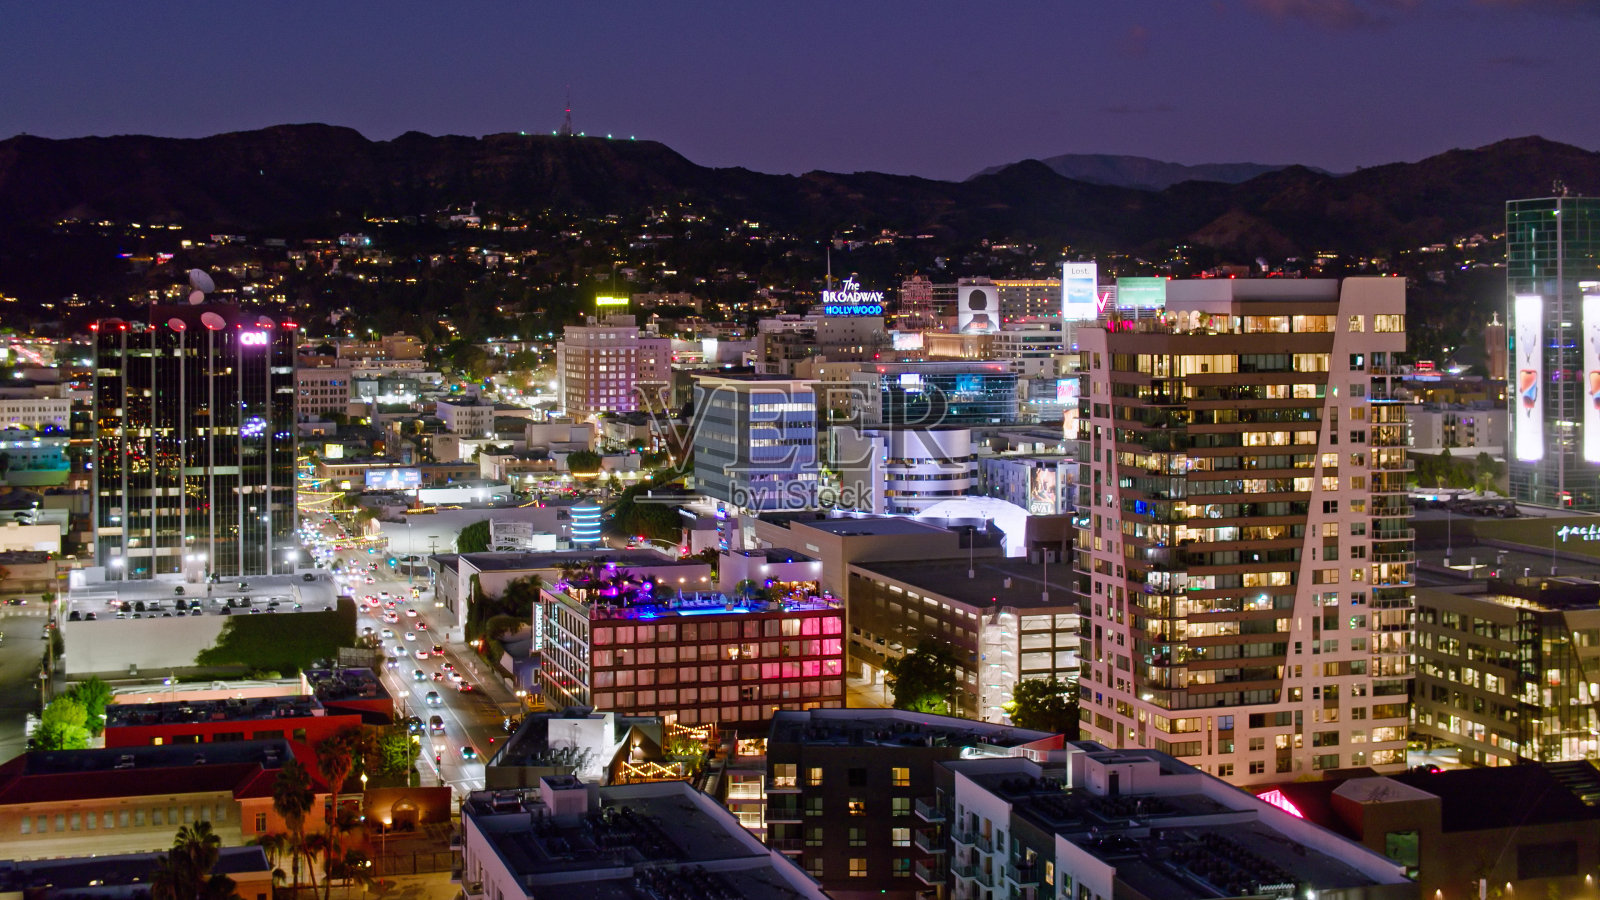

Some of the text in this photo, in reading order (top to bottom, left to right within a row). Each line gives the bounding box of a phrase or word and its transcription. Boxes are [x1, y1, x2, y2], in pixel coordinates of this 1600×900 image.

[843, 277, 860, 297] The
[823, 291, 884, 302] BROADWAY
[826, 305, 882, 315] HOLLYWOOD
[241, 331, 267, 344] CNN
[535, 604, 543, 651] THE GODFREY
